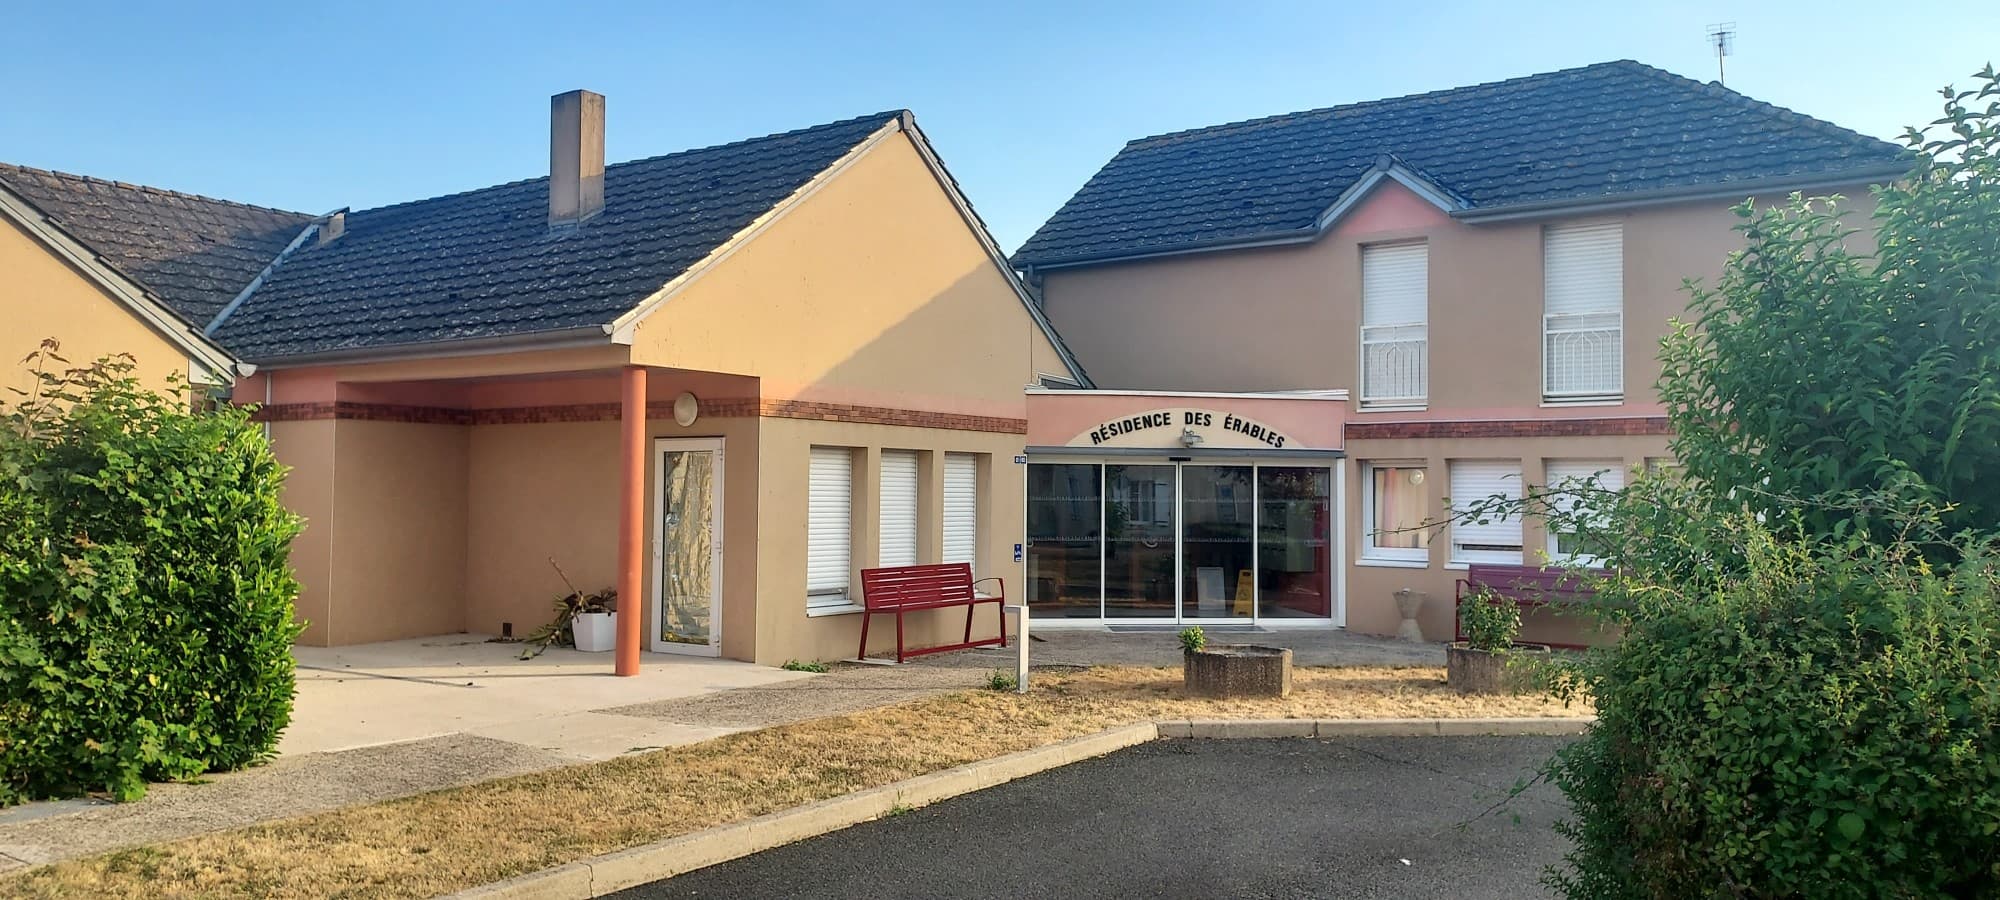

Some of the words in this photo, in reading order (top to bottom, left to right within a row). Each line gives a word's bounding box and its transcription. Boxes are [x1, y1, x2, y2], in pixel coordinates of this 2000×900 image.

[1090, 412, 1171, 446] RÉSIDENCE
[1184, 411, 1212, 427] DES
[1223, 413, 1285, 449] ÉRABLES
